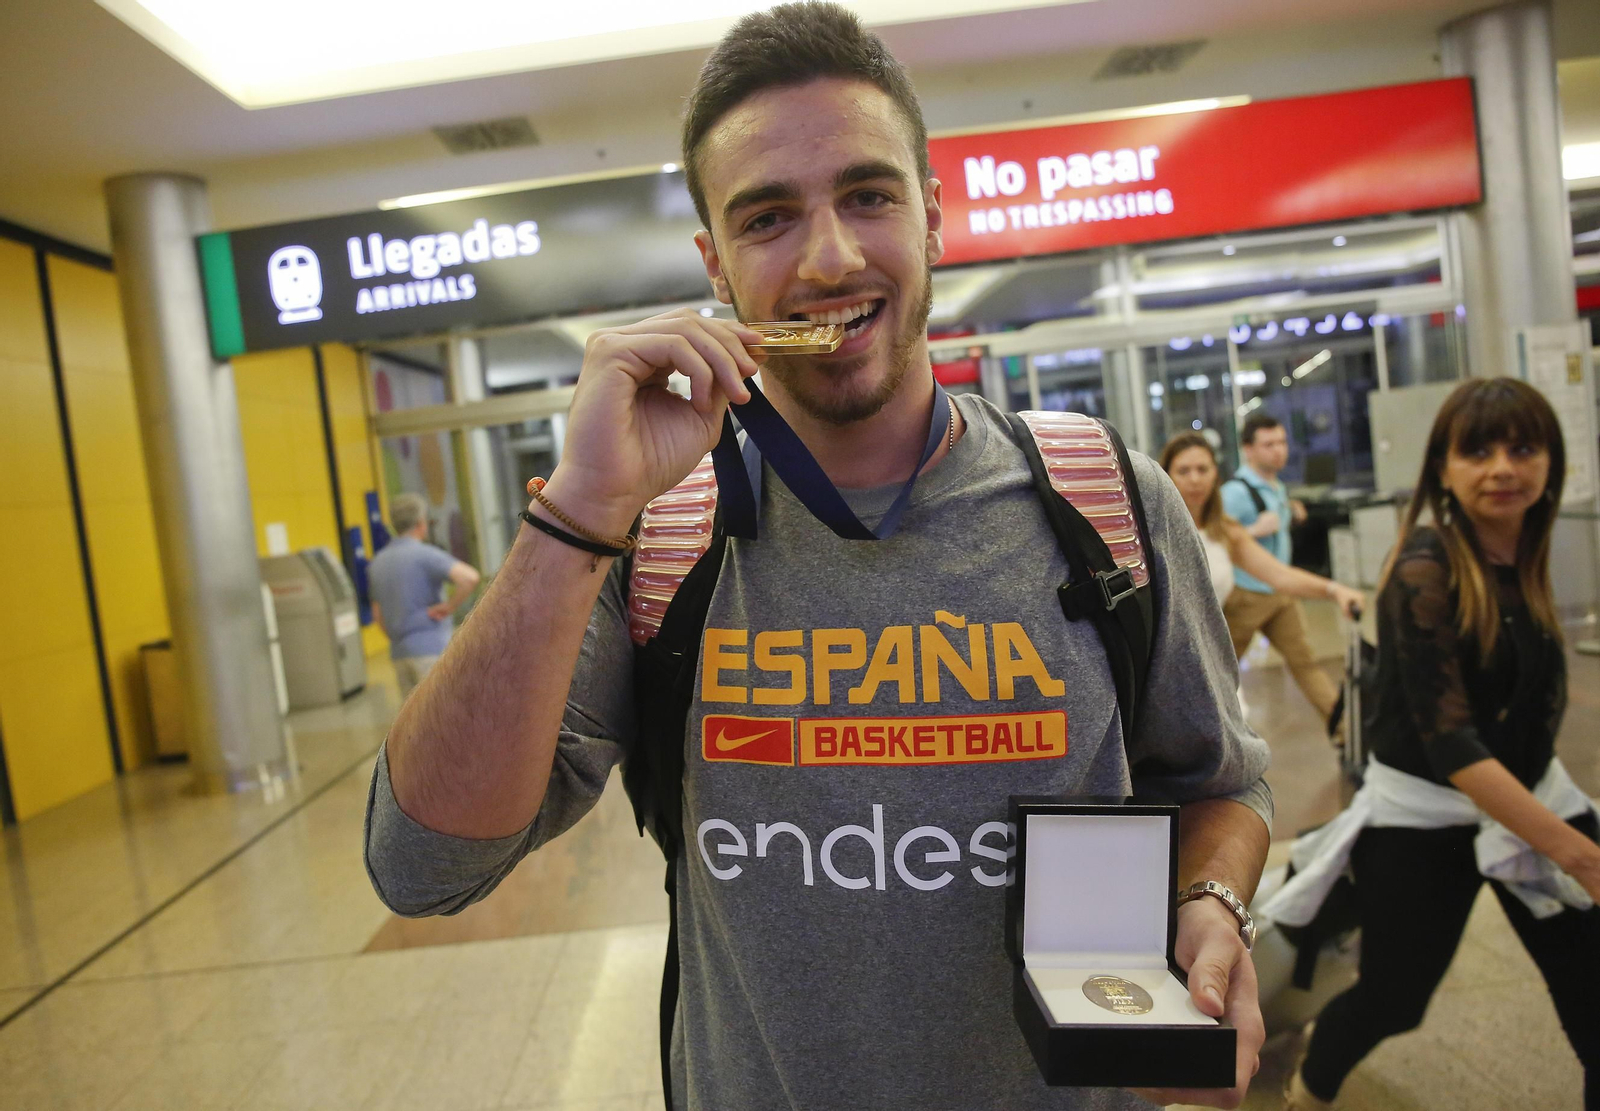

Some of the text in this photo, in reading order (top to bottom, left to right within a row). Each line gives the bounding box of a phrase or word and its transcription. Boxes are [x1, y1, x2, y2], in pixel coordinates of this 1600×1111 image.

[964, 146, 1159, 200] No pasar
[969, 189, 1174, 234] NO TRESPASSING
[347, 219, 541, 279] Llegadas
[356, 274, 477, 314] ARRIVALS
[702, 610, 1066, 704] ESPAÑA
[814, 721, 1053, 758] BASKETBALL
